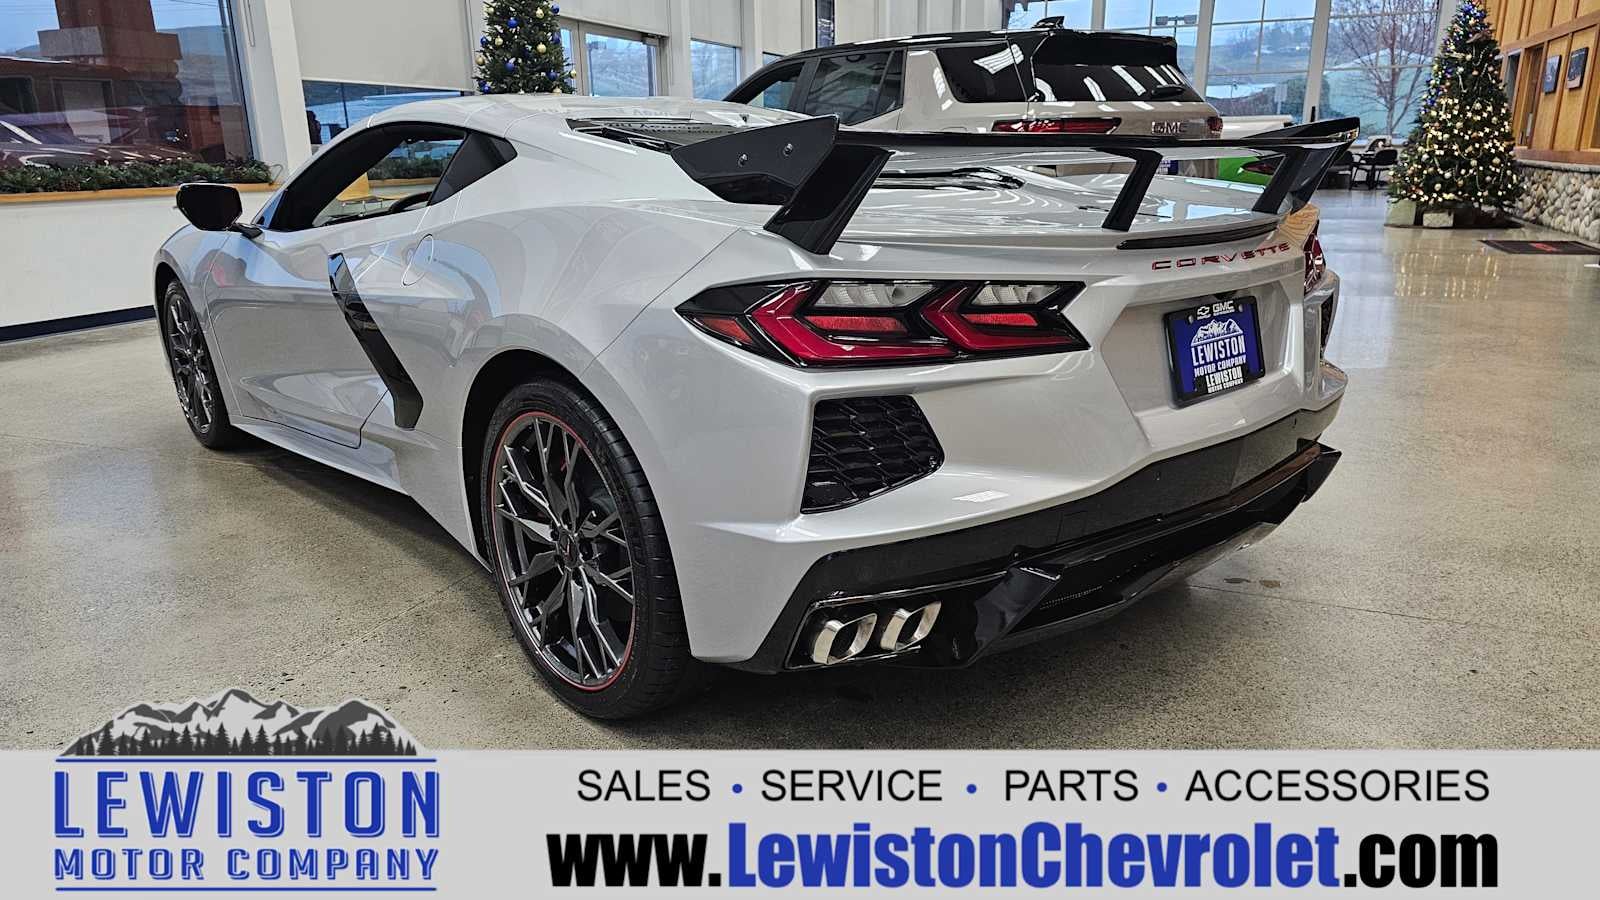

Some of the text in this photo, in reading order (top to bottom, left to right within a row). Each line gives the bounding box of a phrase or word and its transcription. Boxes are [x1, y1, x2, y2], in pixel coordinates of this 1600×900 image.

[1151, 121, 1186, 134] GMC
[1152, 242, 1290, 270] CORVETTE
[1212, 300, 1234, 313] GMC
[1191, 335, 1246, 366] LEWISTON
[1194, 354, 1246, 377] MOTOR COMPANY
[1205, 366, 1242, 387] LEWISTON
